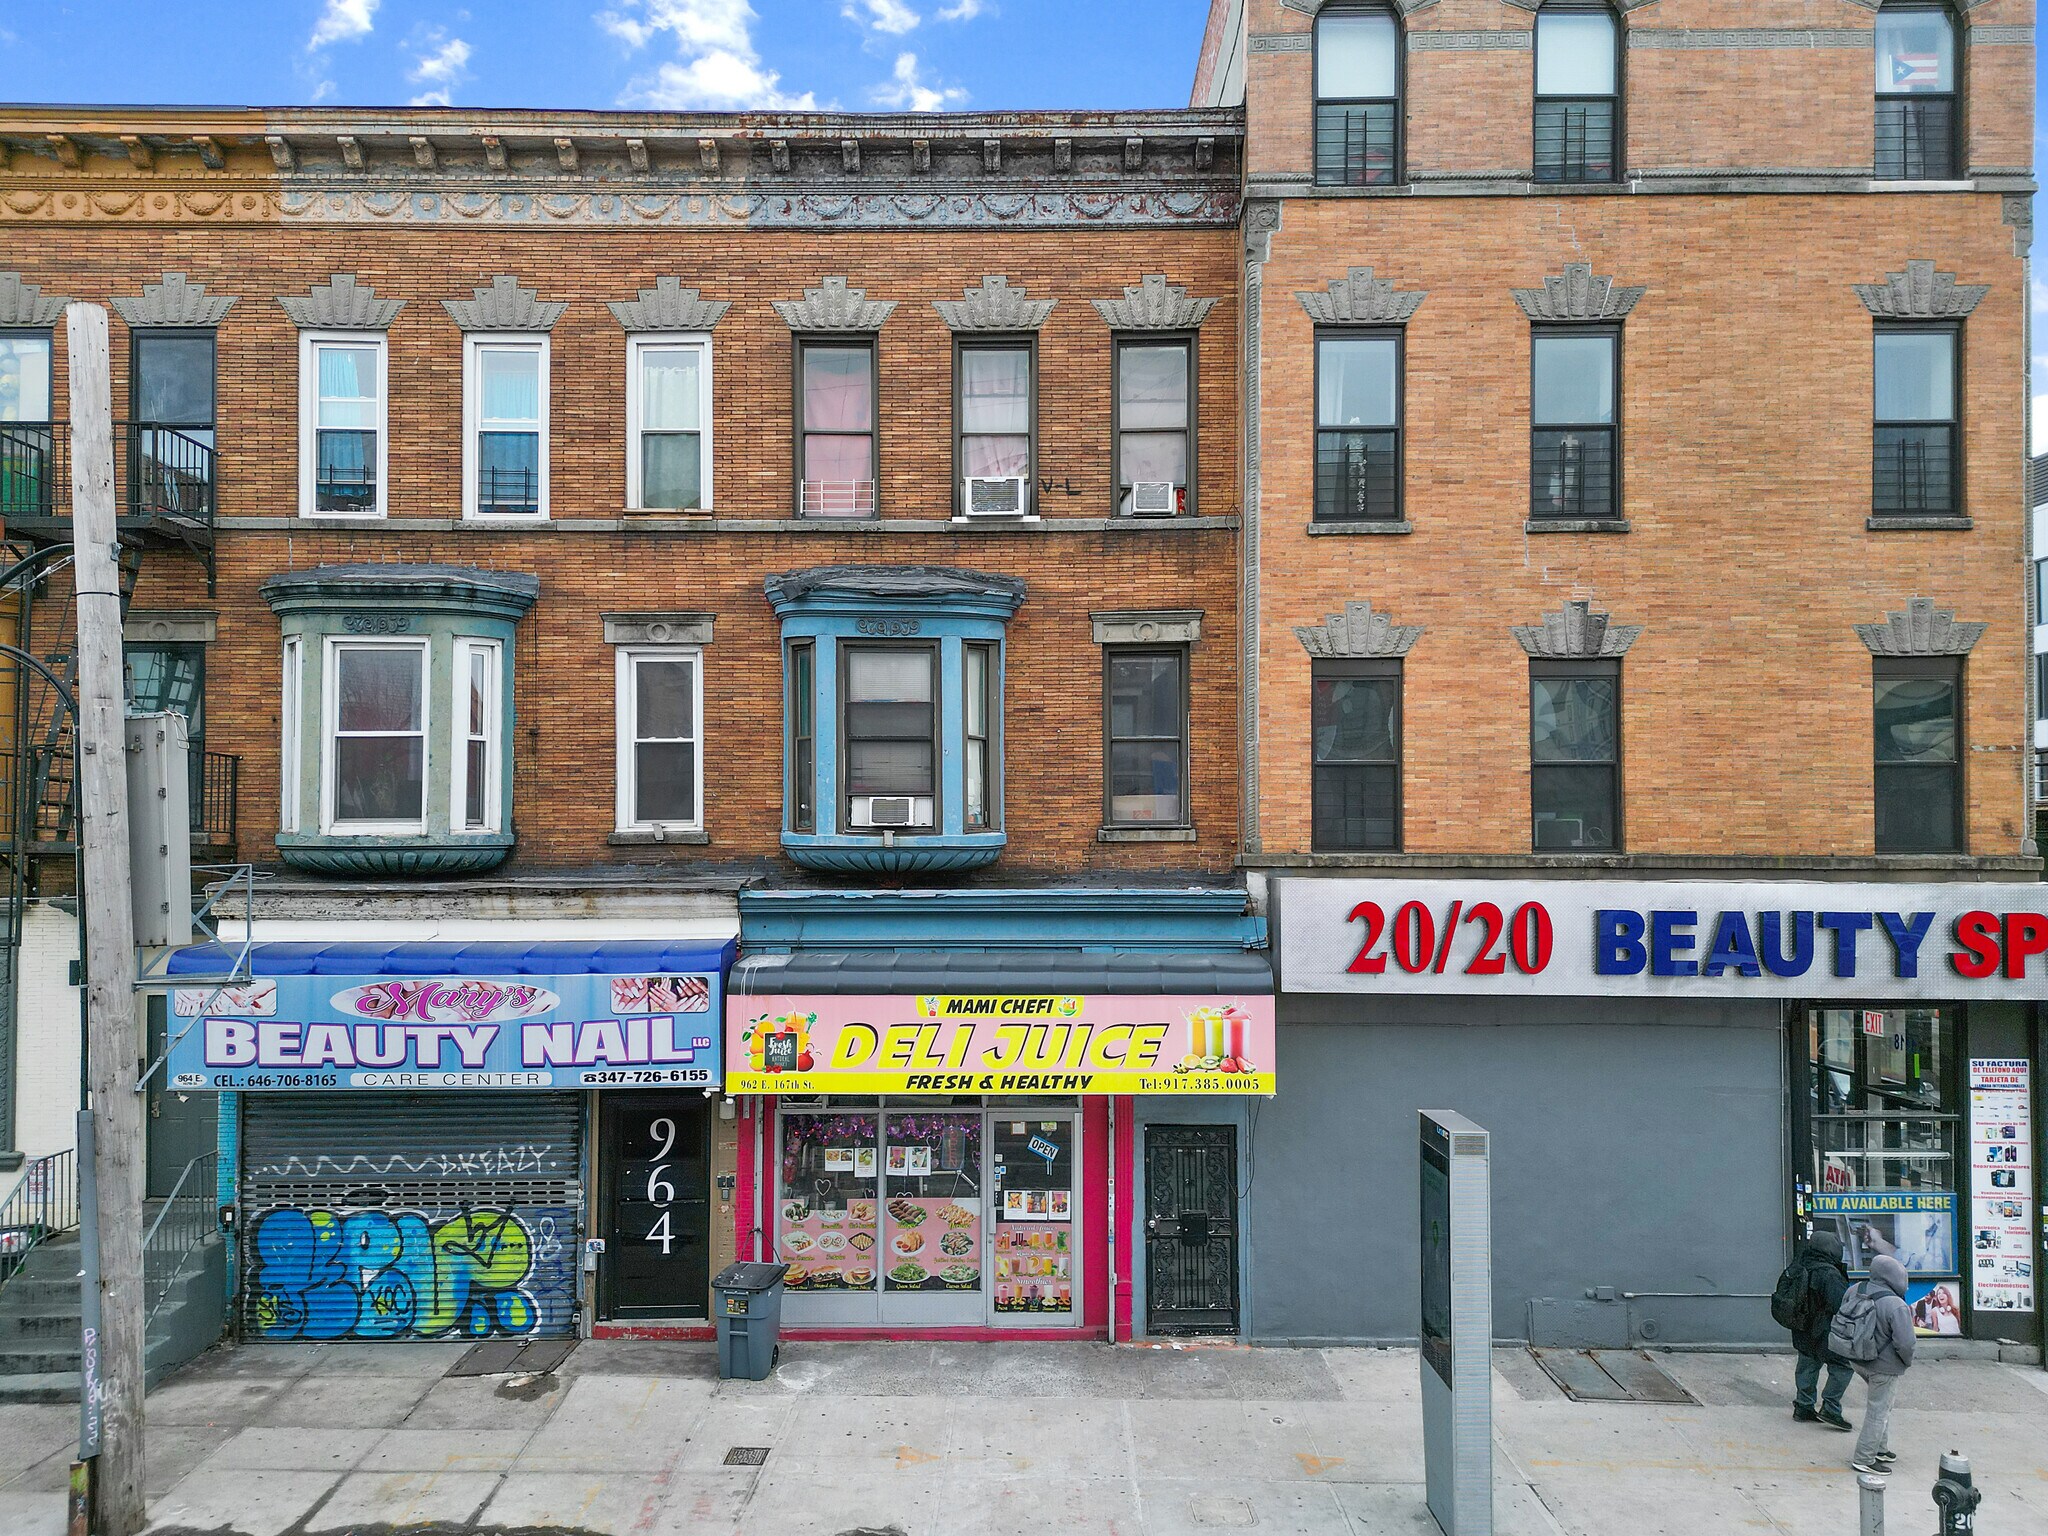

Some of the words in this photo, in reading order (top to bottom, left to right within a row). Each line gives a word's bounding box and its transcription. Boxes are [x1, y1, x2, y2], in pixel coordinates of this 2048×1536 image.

[1346, 899, 1554, 975] 20/20
[1594, 909, 1937, 979] BEAUTY
[1947, 910, 2048, 979] SP
[355, 981, 537, 1022] Mary's
[946, 998, 998, 1014] MAMI
[1000, 998, 1055, 1014] CHEFI
[1865, 1012, 1883, 1035] EXIT
[203, 1017, 500, 1068] BEAUTY
[521, 1015, 695, 1067] NAIL
[692, 1037, 711, 1048] LLC
[768, 1036, 793, 1050] Fresh
[829, 1022, 976, 1070] DELI
[980, 1022, 1170, 1070] JUICE
[178, 1074, 193, 1083] 964
[195, 1074, 203, 1082] E.
[213, 1075, 244, 1087] CEL.:
[247, 1074, 337, 1087] 646-706-8165
[363, 1073, 429, 1086] CARE
[451, 1073, 540, 1086] CENTER
[598, 1070, 709, 1084] 347-726-6155
[741, 1080, 757, 1090] 962
[761, 1080, 770, 1090] E.
[774, 1079, 800, 1090] 167th
[803, 1080, 815, 1090] St.
[906, 1074, 974, 1090] FRESH
[979, 1075, 994, 1090] &
[1000, 1074, 1094, 1090] HEALTHY
[1139, 1078, 1260, 1090] Tel:917.385.0005
[1032, 1139, 1056, 1158] OPEN
[645, 1117, 676, 1255] 964
[1841, 1196, 1913, 1209] AVAILABLE
[1917, 1195, 1952, 1209] HERE
